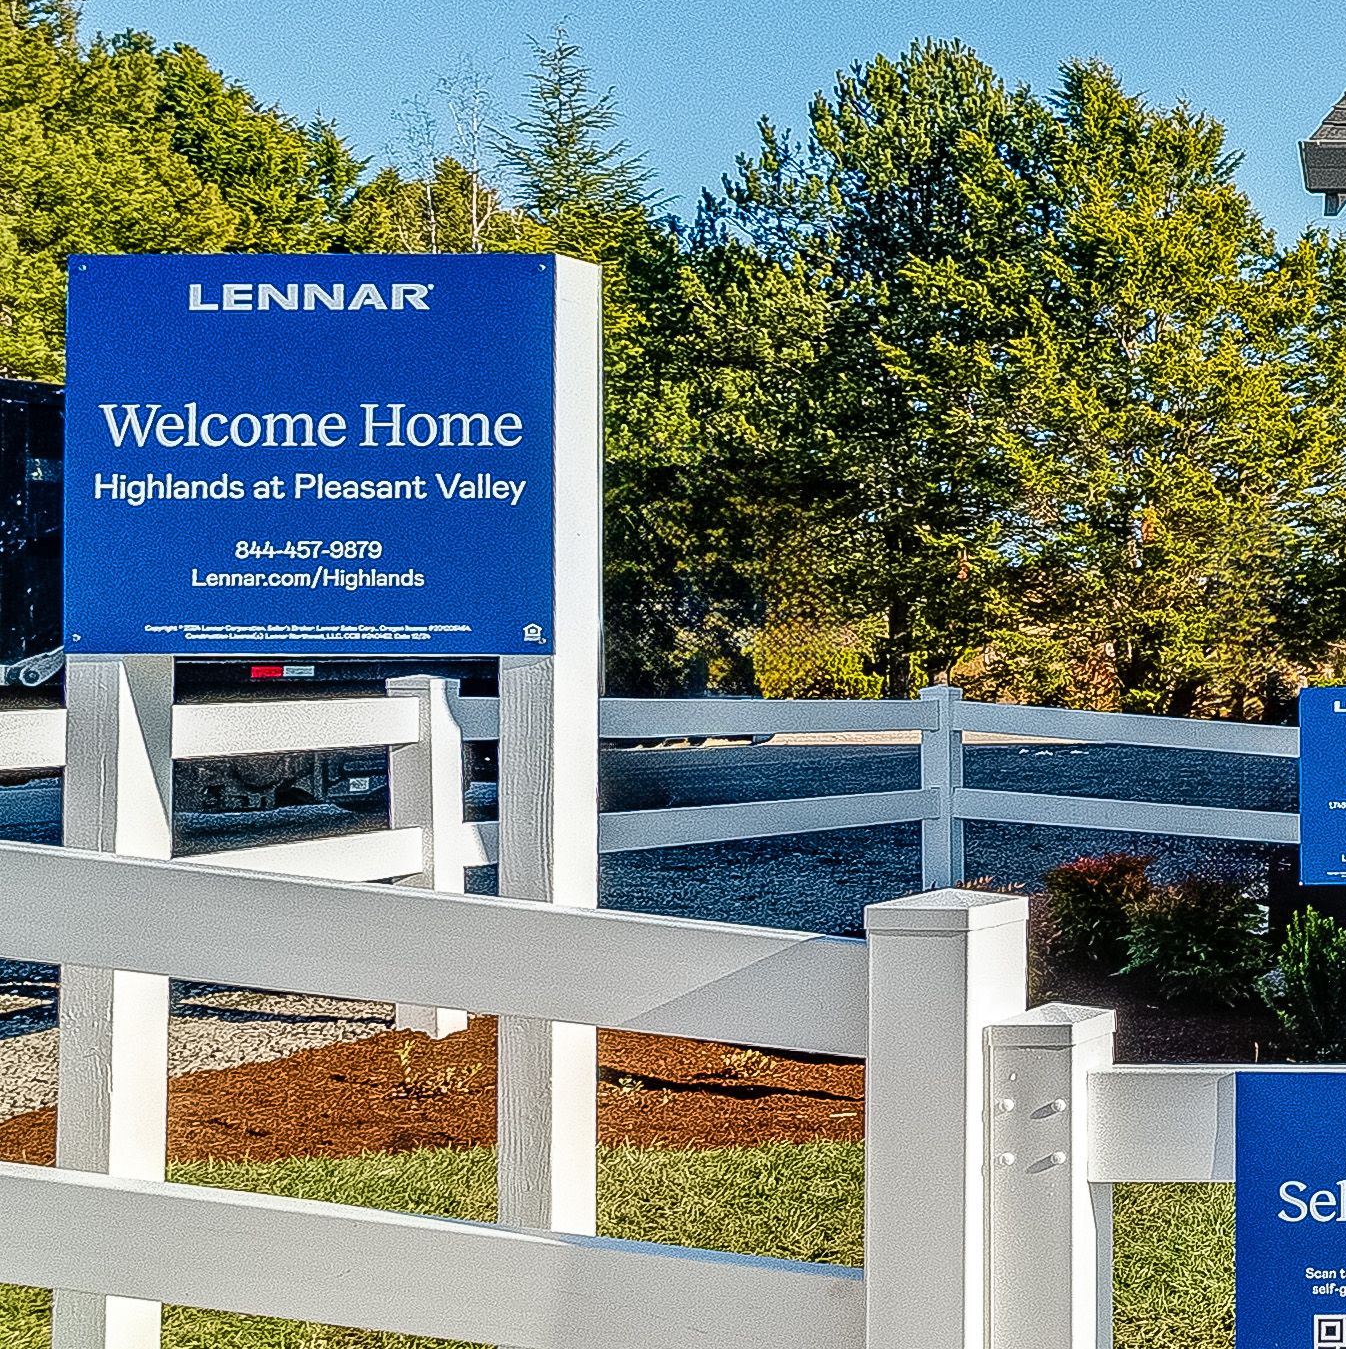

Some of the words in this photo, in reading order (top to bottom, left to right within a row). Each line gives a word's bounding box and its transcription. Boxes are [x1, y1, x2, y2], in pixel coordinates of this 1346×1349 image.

[188, 283, 434, 311] LENNAR
[98, 401, 347, 448] Welcome
[359, 403, 523, 448] Home
[94, 473, 245, 506] Highlands
[253, 475, 286, 500] at
[294, 473, 428, 500] Pleasant
[434, 472, 527, 506] Valley
[234, 540, 383, 560] 844-457-9879
[191, 565, 425, 591] Lennar.com/Highlands
[1305, 1267, 1337, 1280] Scan
